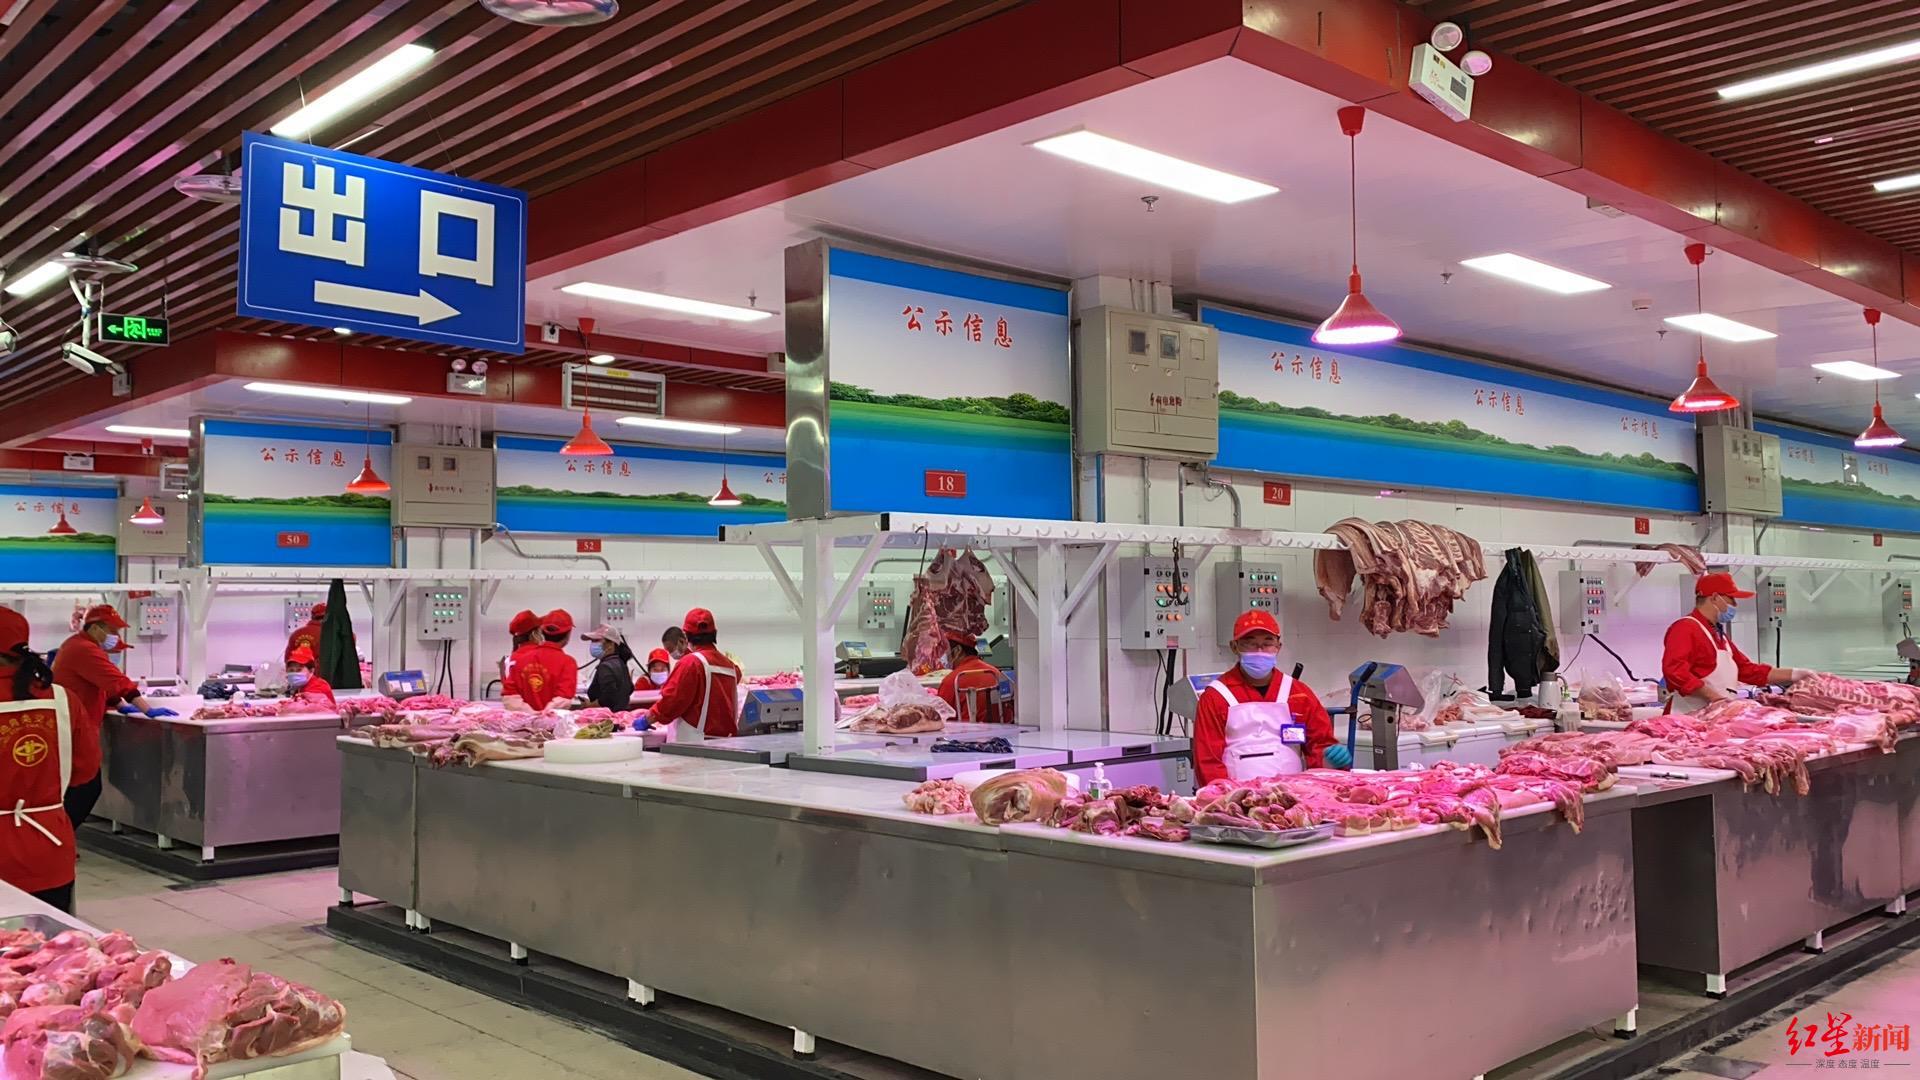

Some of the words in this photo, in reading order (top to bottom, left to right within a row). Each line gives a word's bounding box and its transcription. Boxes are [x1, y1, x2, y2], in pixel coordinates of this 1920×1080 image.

[279, 161, 495, 286] 出口
[903, 305, 1014, 349] 公示信息
[1271, 351, 1341, 384] 公示信息
[1473, 389, 1524, 415] 公示信息
[260, 447, 346, 468] 公示信息
[564, 458, 632, 477] 公示信息
[937, 474, 956, 492] 18
[1271, 486, 1287, 502] 20
[15, 501, 81, 514] 公示信息
[285, 533, 301, 546] 50
